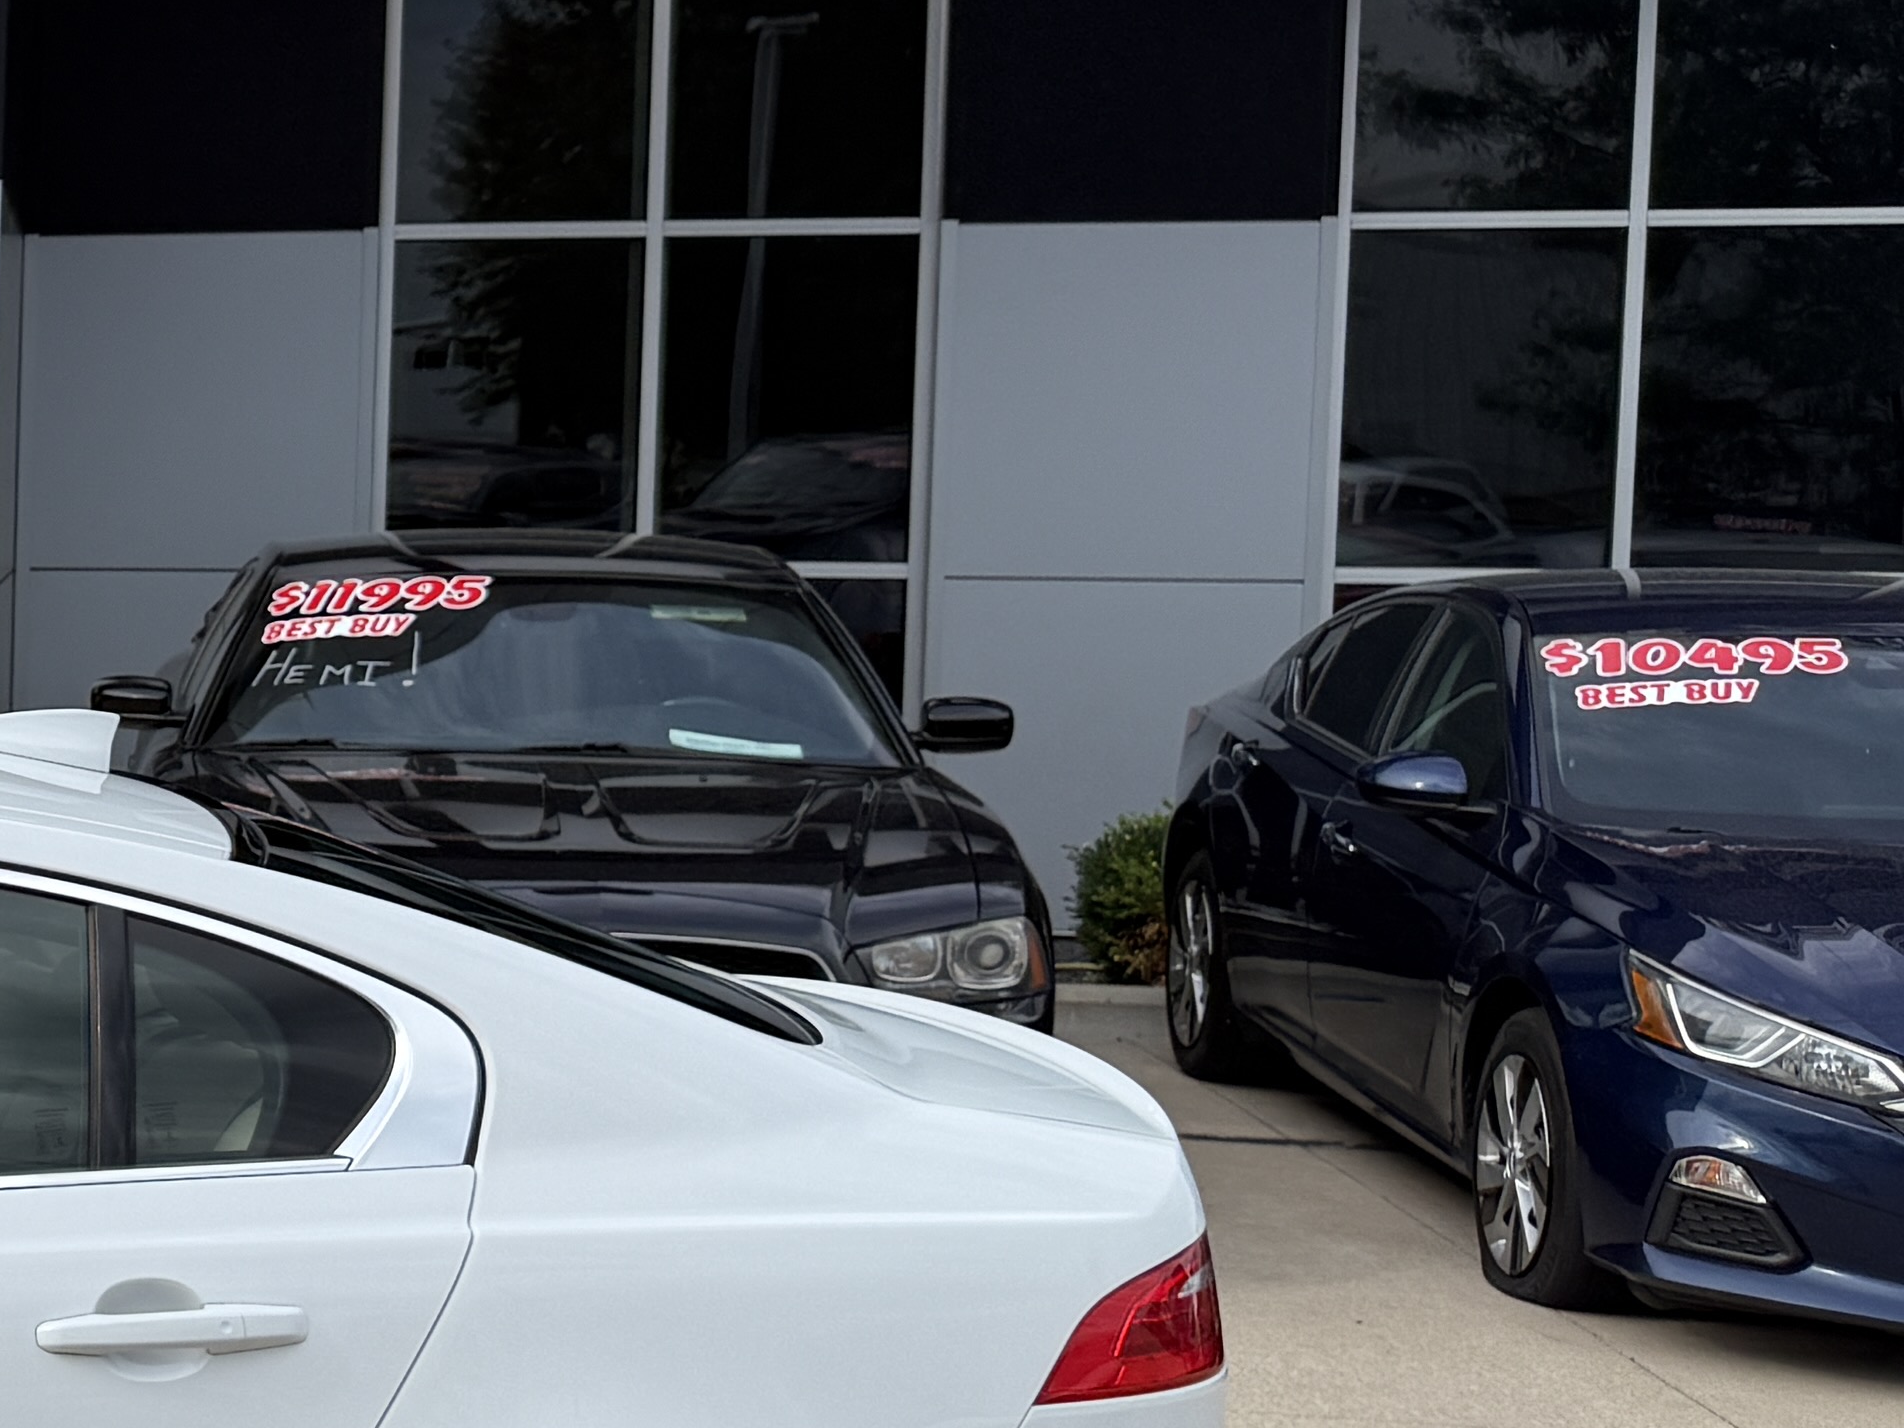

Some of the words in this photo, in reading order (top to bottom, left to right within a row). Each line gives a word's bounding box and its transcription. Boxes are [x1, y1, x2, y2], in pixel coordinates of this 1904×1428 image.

[267, 575, 493, 617] $11995
[261, 618, 344, 645] BEST
[347, 614, 418, 637] BUY
[1540, 637, 1849, 678] $10495
[1575, 681, 1674, 710] BEST
[1682, 678, 1760, 704] BUY
